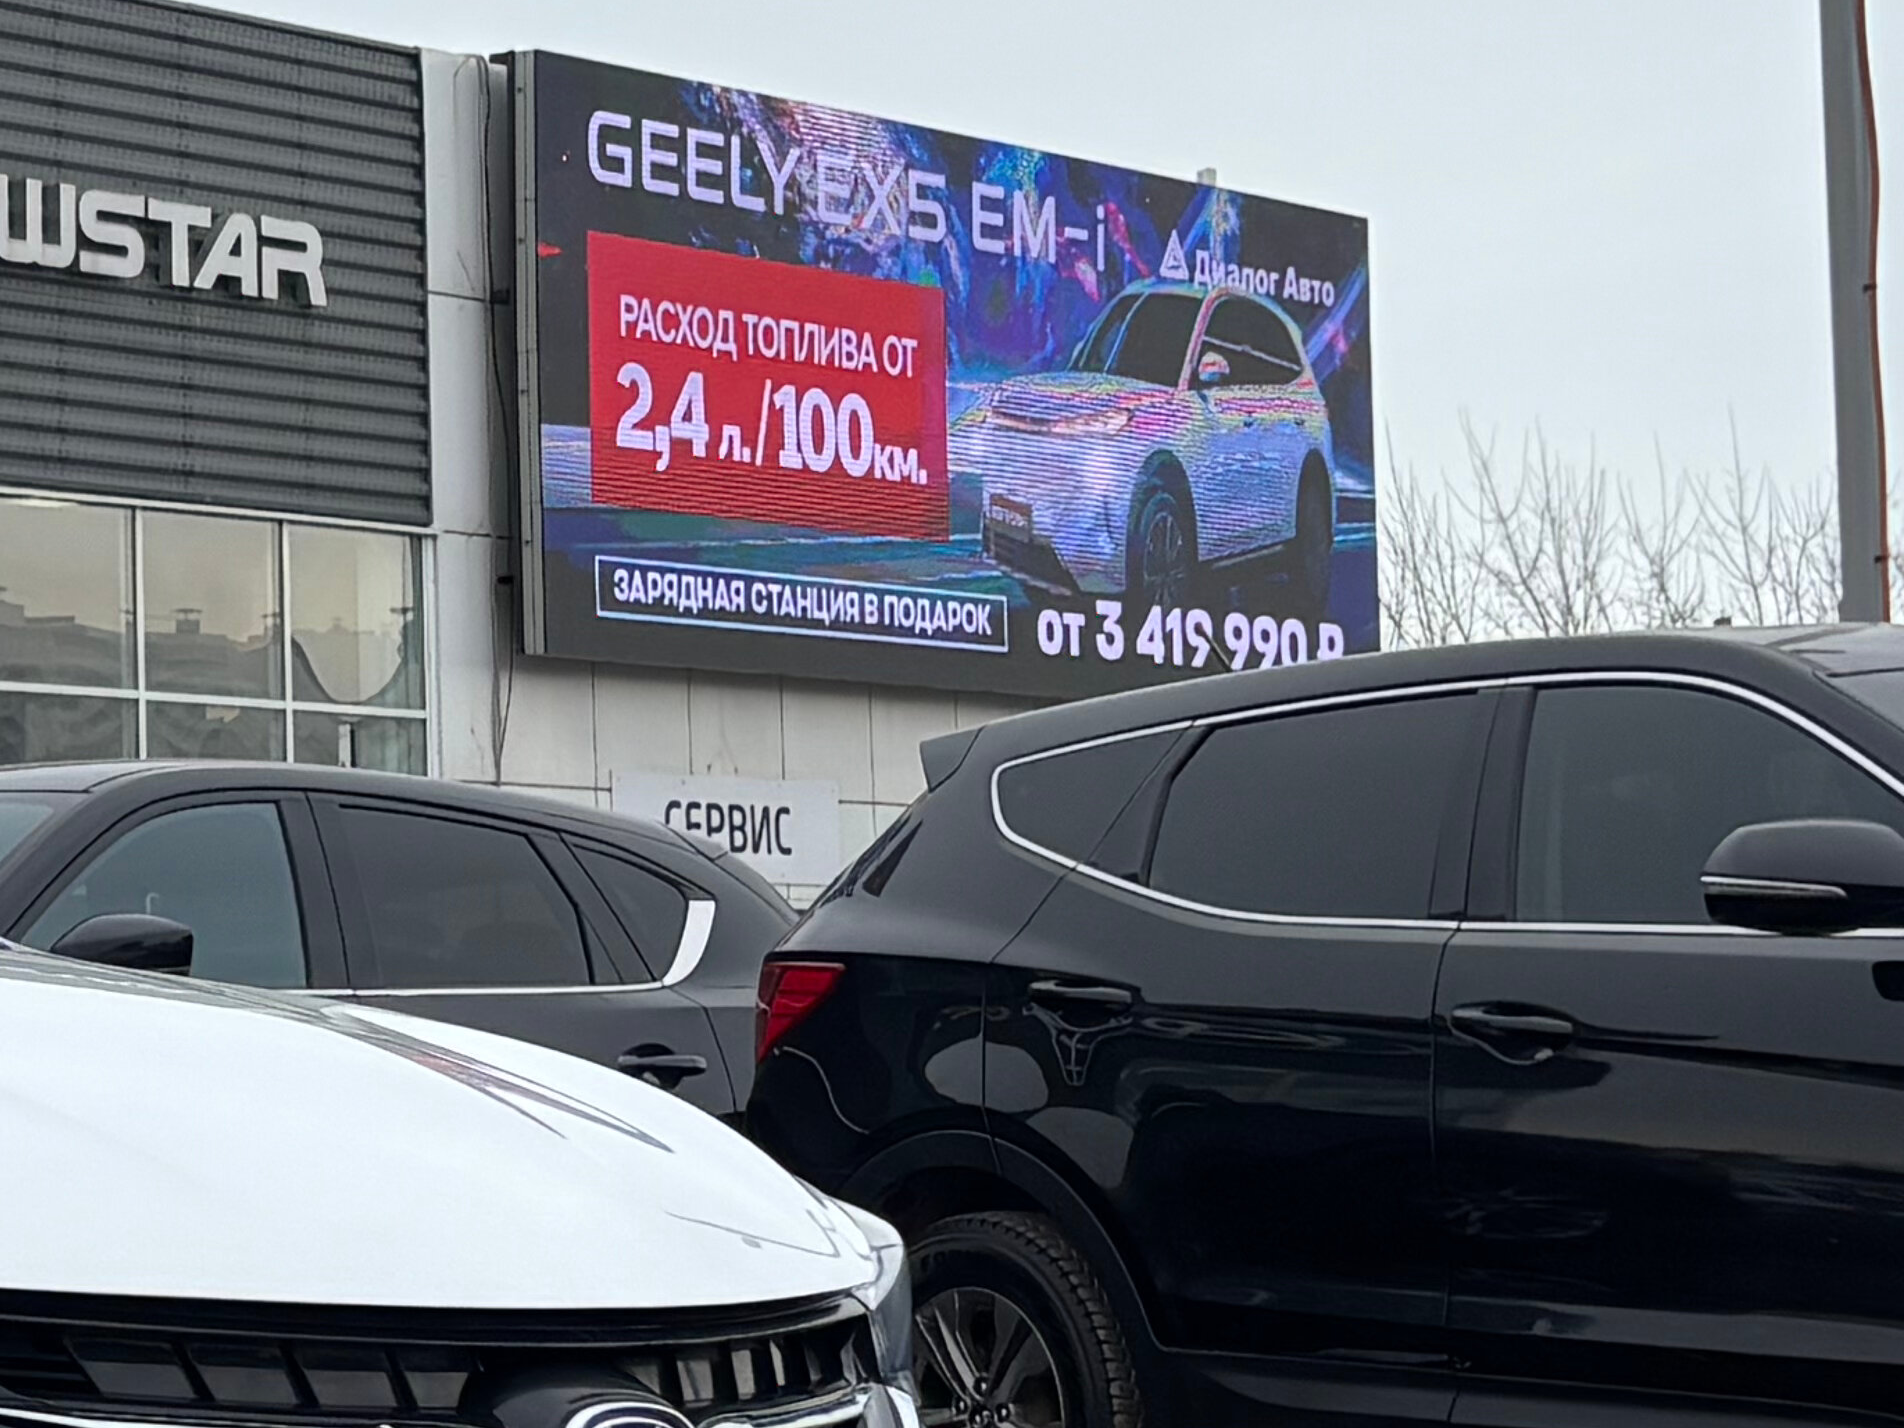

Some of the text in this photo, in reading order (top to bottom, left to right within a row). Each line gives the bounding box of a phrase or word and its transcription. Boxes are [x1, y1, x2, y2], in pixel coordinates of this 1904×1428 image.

[587, 110, 1105, 272] GEELY EX5 EM-i
[1194, 248, 1335, 308] Диалог Авто
[619, 294, 918, 378] РАСХОД ТОПЛИВА ОТ
[616, 361, 710, 472] 2,4
[612, 568, 993, 636] ЗАРЯДНАЯ СТАНЦИЯ В ПОДАРОК
[1095, 599, 1126, 661] 3
[1136, 605, 1214, 669] 419
[1223, 611, 1308, 671] 990
